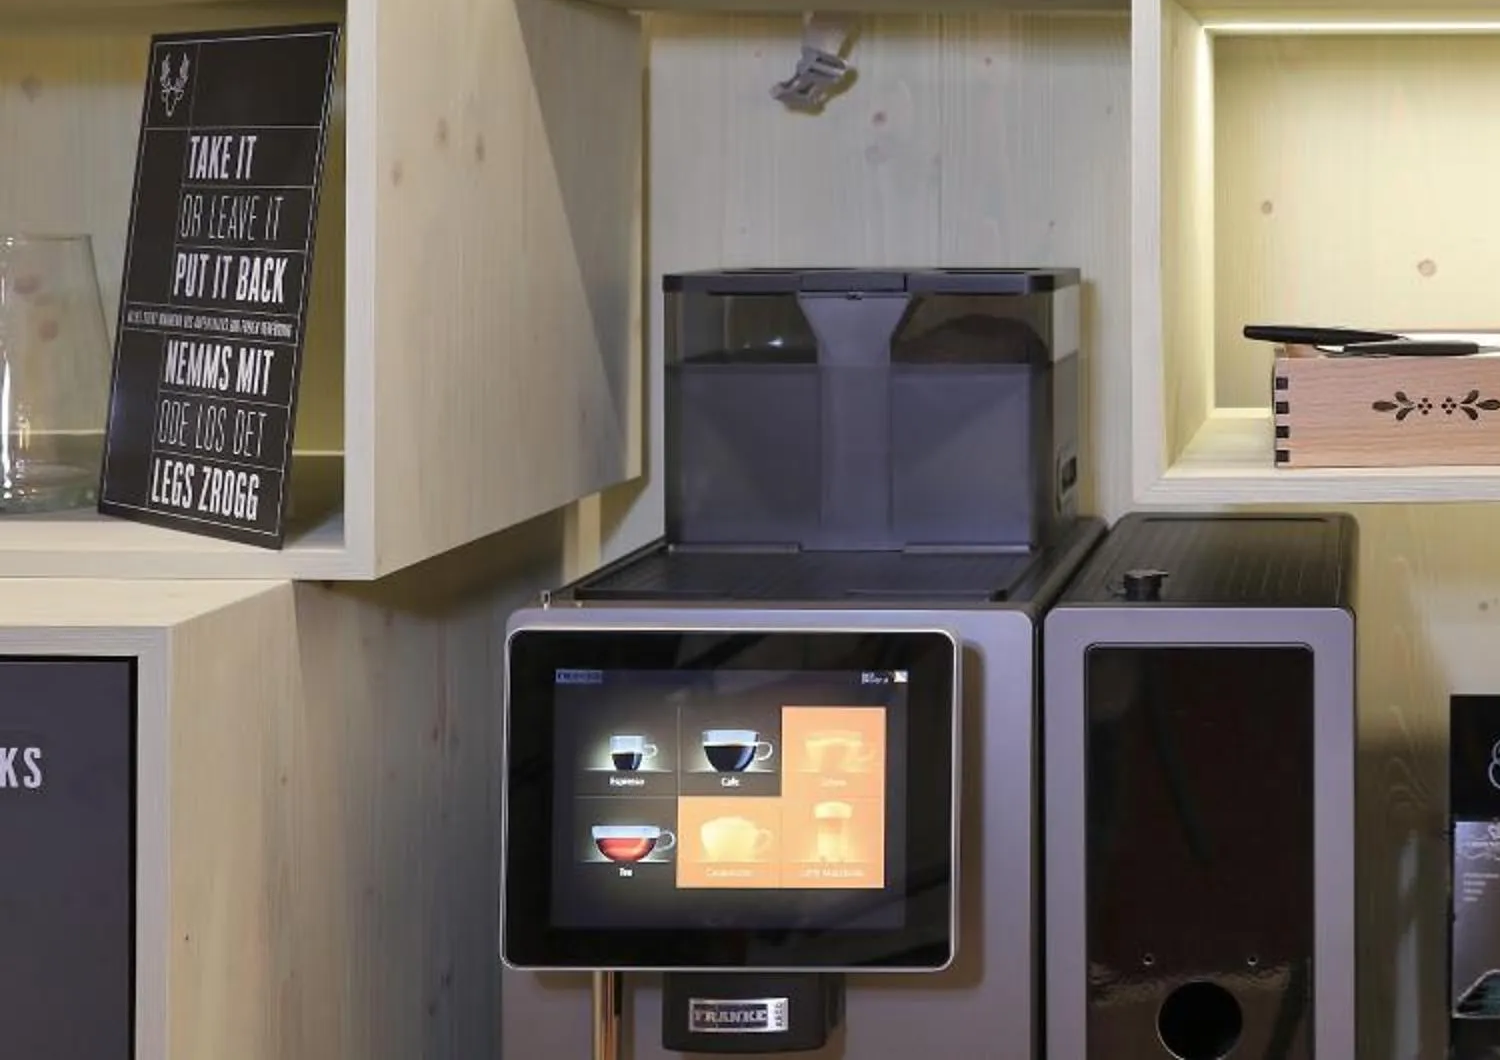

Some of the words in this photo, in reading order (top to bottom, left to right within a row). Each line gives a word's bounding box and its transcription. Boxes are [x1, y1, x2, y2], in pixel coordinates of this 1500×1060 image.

[189, 136, 232, 179] TAKE
[236, 136, 257, 180] IT
[181, 194, 203, 238] OR
[209, 195, 260, 240] LEAVE
[265, 196, 284, 240] IT
[174, 252, 210, 299] PUT
[212, 255, 233, 299] IT
[236, 256, 288, 303] BACK
[165, 340, 232, 391] NEMMS
[236, 348, 274, 396] MIT
[159, 399, 191, 447] ODE
[195, 404, 227, 453] LOS
[233, 409, 267, 457] DET
[151, 457, 195, 509] LEGS
[198, 466, 260, 521] ZROGG
[695, 1009, 767, 1023] FRANKE
